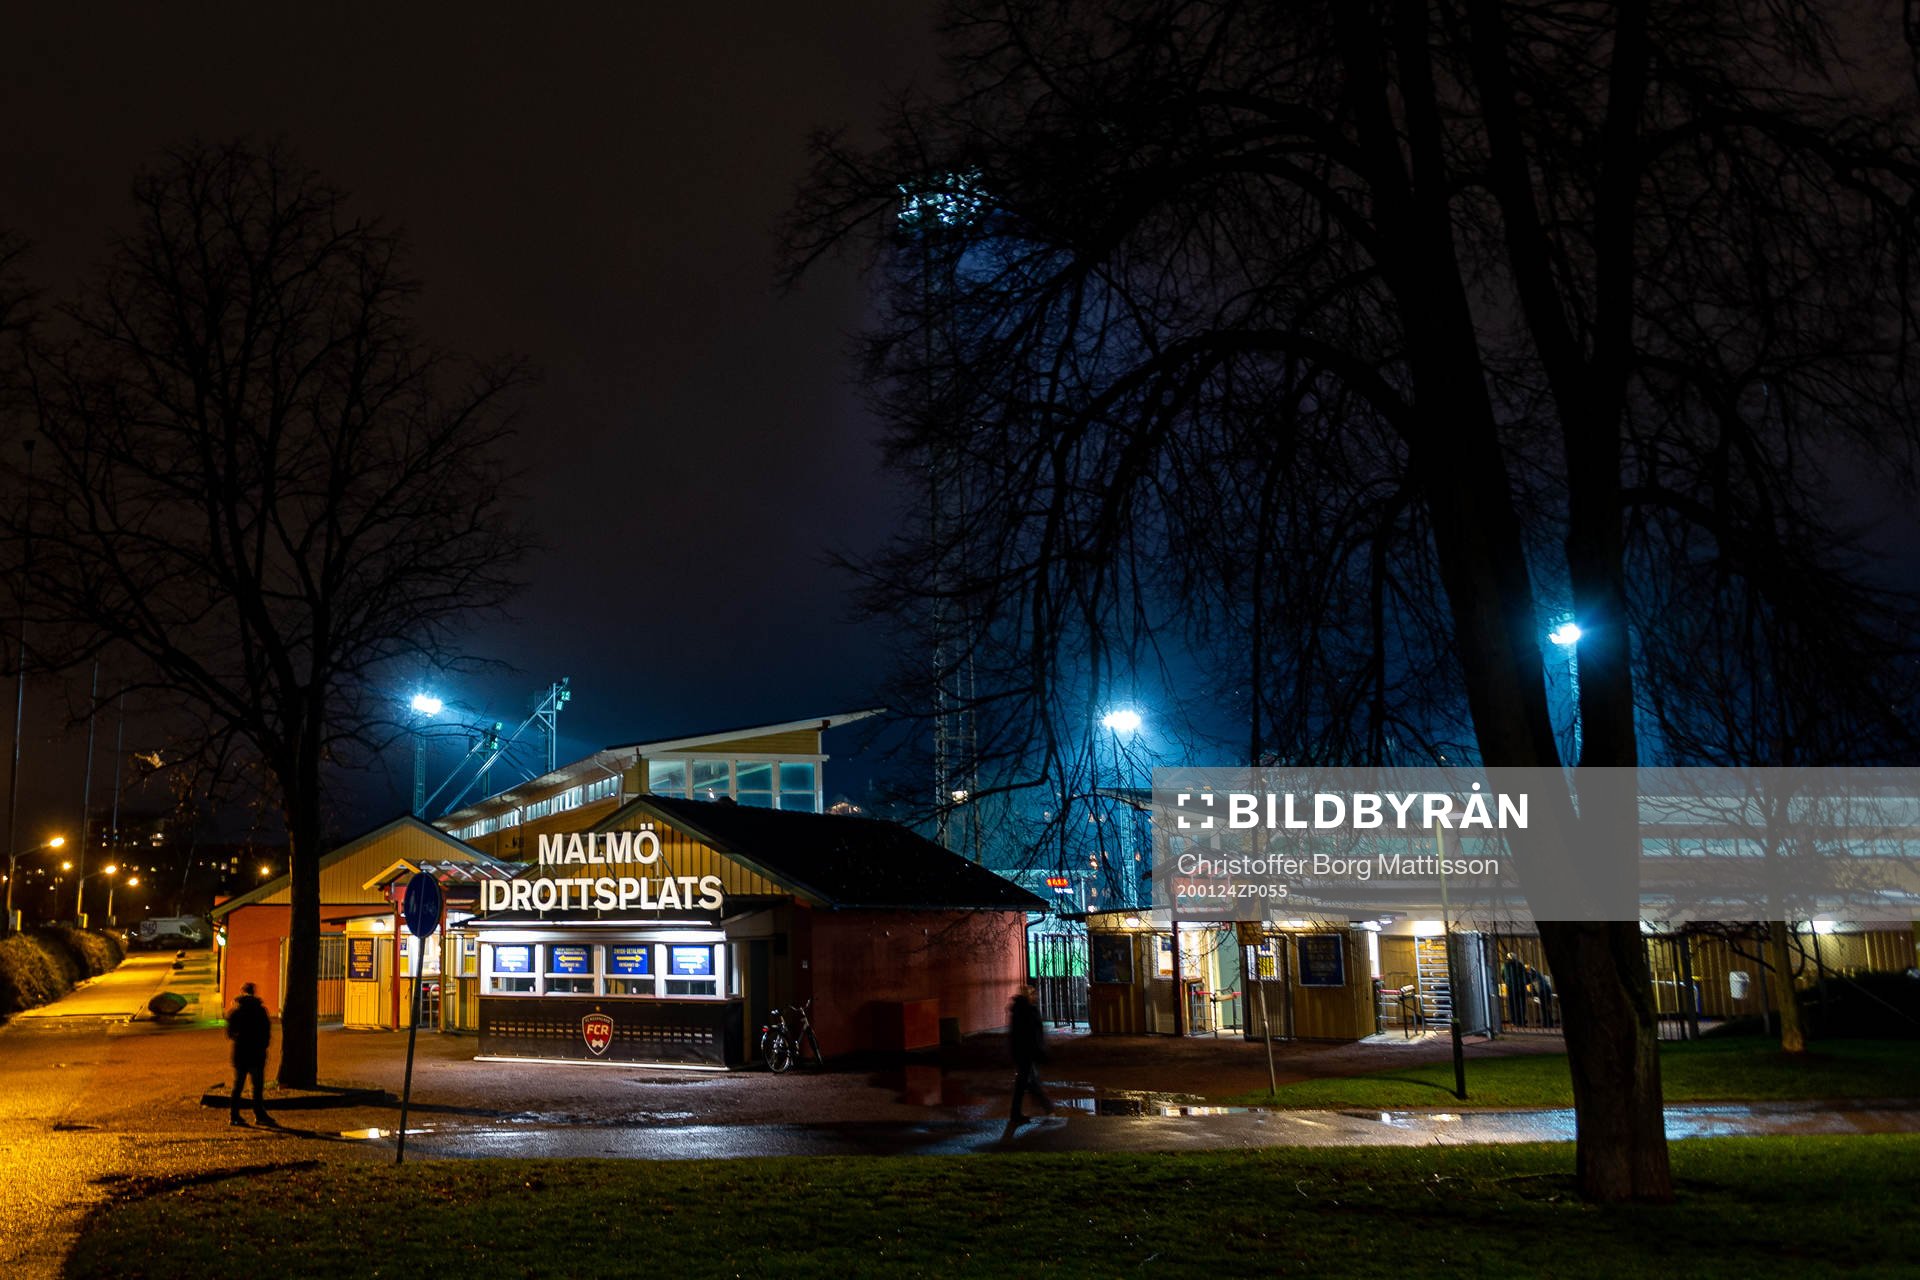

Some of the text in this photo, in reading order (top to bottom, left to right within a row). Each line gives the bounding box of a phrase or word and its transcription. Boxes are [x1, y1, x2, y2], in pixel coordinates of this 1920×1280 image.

[538, 823, 660, 865] MALMÖ
[480, 875, 723, 911] IDROTTSPLATS
[586, 1024, 609, 1036] FCR
